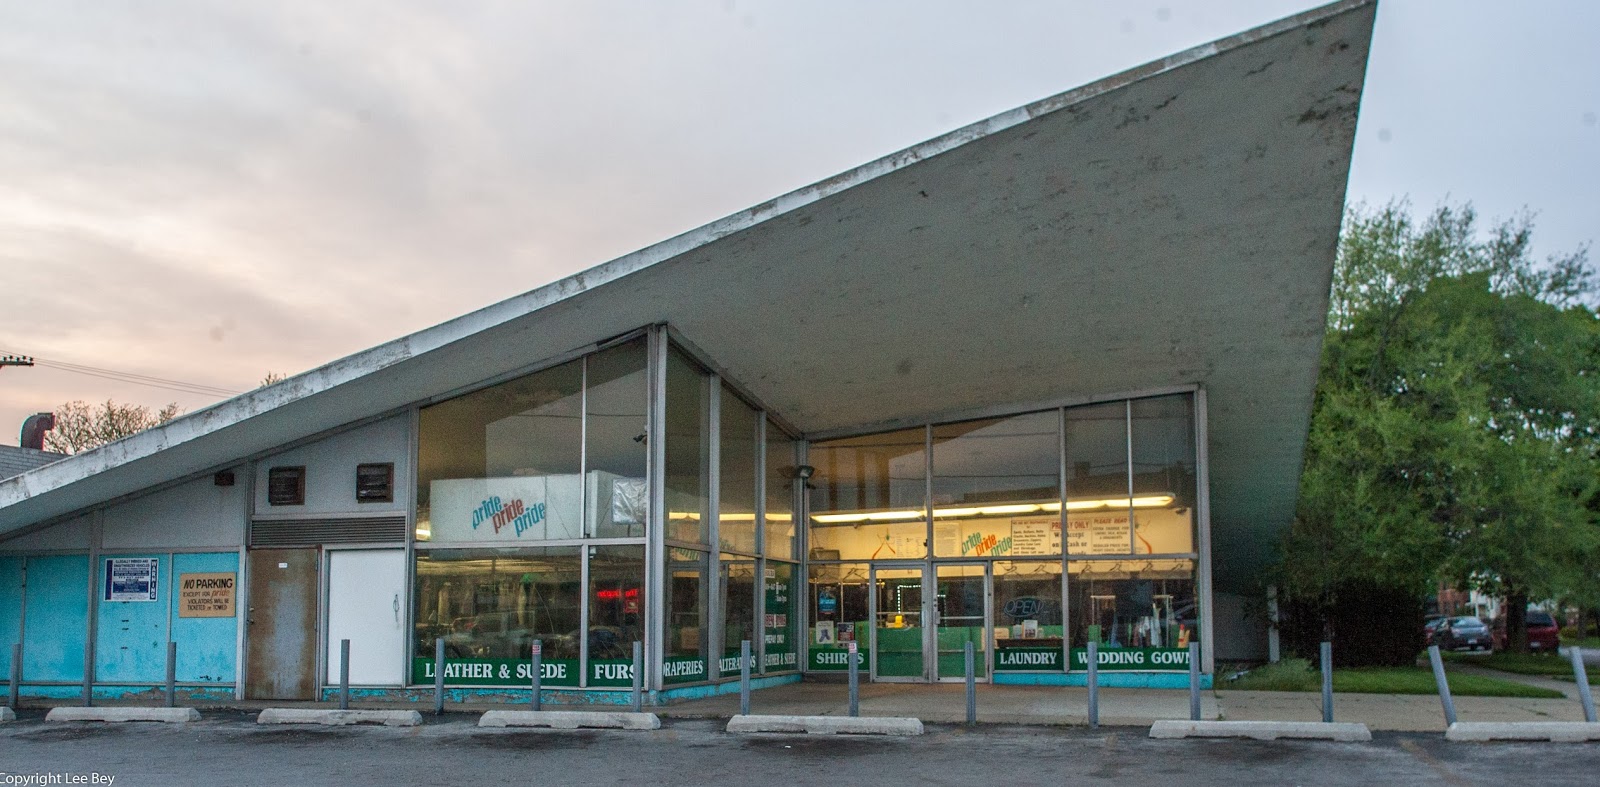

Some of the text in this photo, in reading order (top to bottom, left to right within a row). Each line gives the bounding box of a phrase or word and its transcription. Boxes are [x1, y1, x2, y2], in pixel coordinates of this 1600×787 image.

[472, 496, 545, 537] pride pride pride
[962, 532, 982, 555] pride
[976, 534, 996, 556] pride
[991, 537, 1012, 556] pride
[184, 578, 232, 589] NO PARKING
[211, 588, 230, 598] pride
[1006, 600, 1040, 614] OPEN
[816, 653, 864, 664] SHIRS
[1000, 652, 1056, 664] LAUNDRY
[498, 664, 510, 678] &
